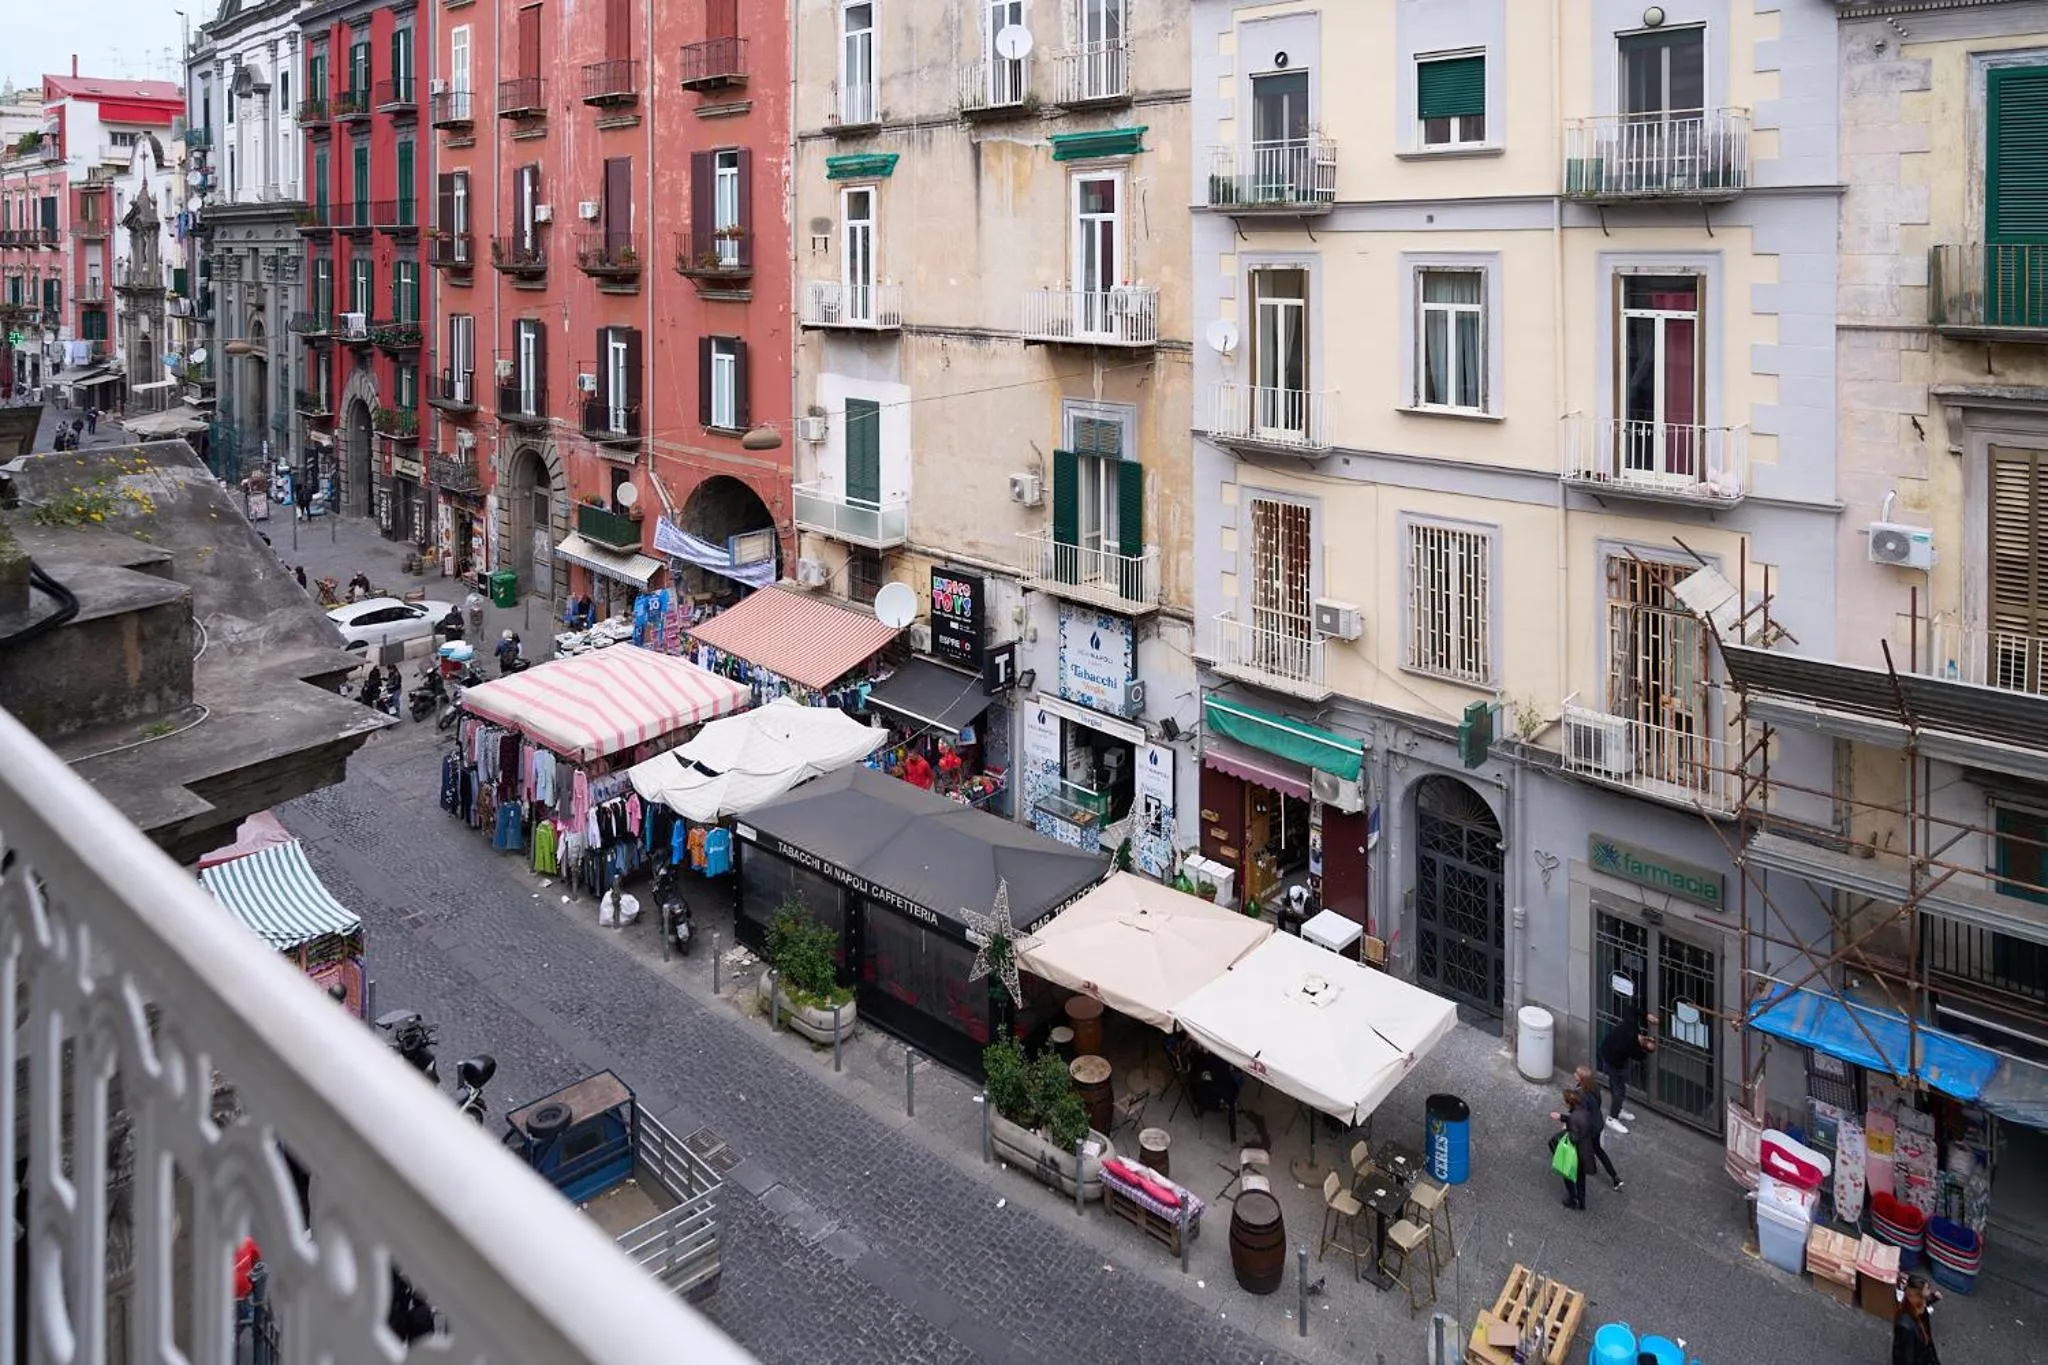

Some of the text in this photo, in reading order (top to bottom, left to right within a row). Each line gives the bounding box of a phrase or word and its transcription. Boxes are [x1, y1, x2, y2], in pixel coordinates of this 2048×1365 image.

[648, 598, 660, 611] 10
[932, 590, 972, 618] TOYS
[994, 652, 1010, 684] T
[1070, 663, 1118, 690] Tabacchi
[777, 841, 939, 927] TABACCHI DI NAPOLI CAFFETTERIA
[1624, 852, 1718, 900] farmacia
[1030, 913, 1050, 934] BAR
[1434, 1134, 1449, 1180] CERES
